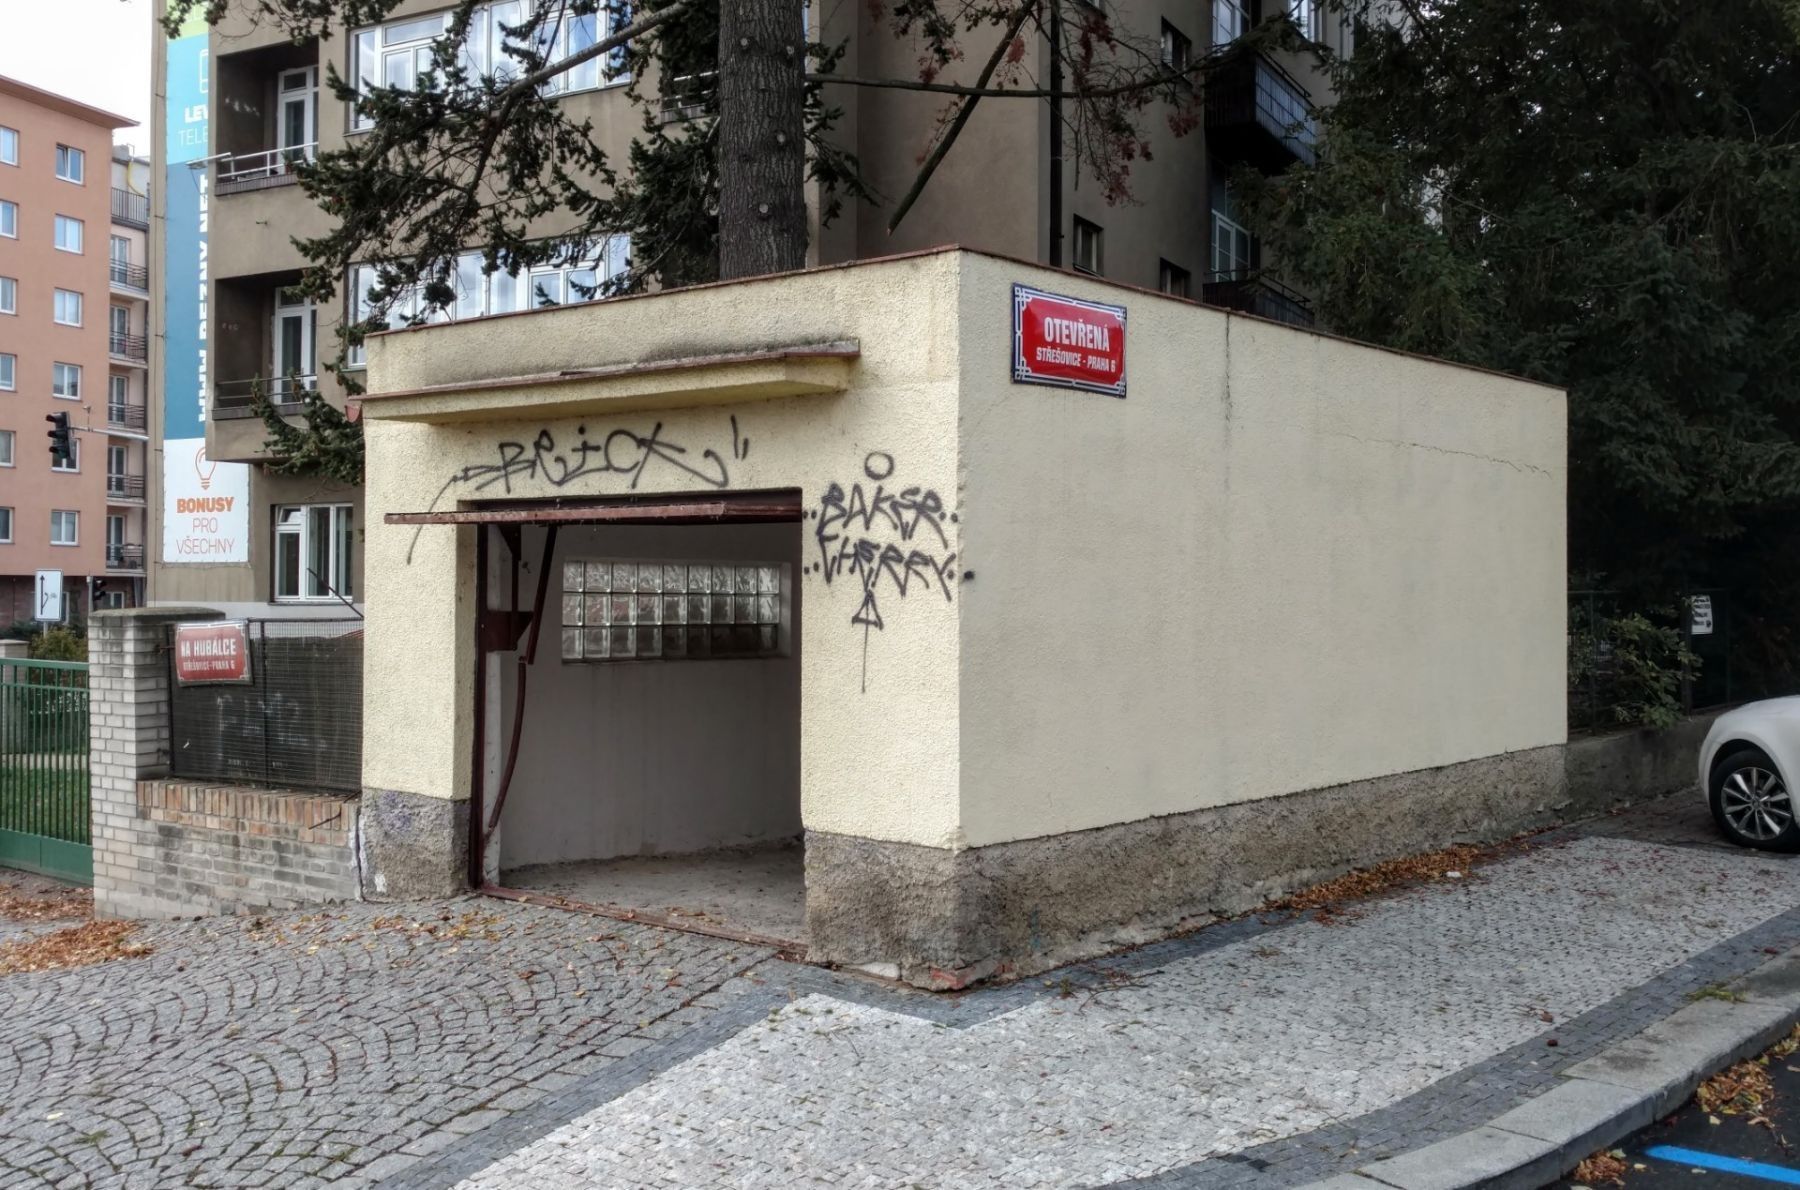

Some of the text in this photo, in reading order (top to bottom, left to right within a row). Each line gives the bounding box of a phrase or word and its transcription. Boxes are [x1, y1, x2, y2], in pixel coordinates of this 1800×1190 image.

[184, 104, 208, 123] LEV
[178, 126, 208, 147] TELE
[1044, 317, 1110, 352] OTEVŘENÁ
[1036, 346, 1081, 367] STŘEŠOVICE
[1087, 355, 1110, 372] PRAHA
[1111, 360, 1116, 373] 6
[176, 497, 235, 513] BONUSY
[192, 517, 219, 533] PRO
[176, 536, 235, 555] VŠECHNY
[181, 640, 191, 657] NA
